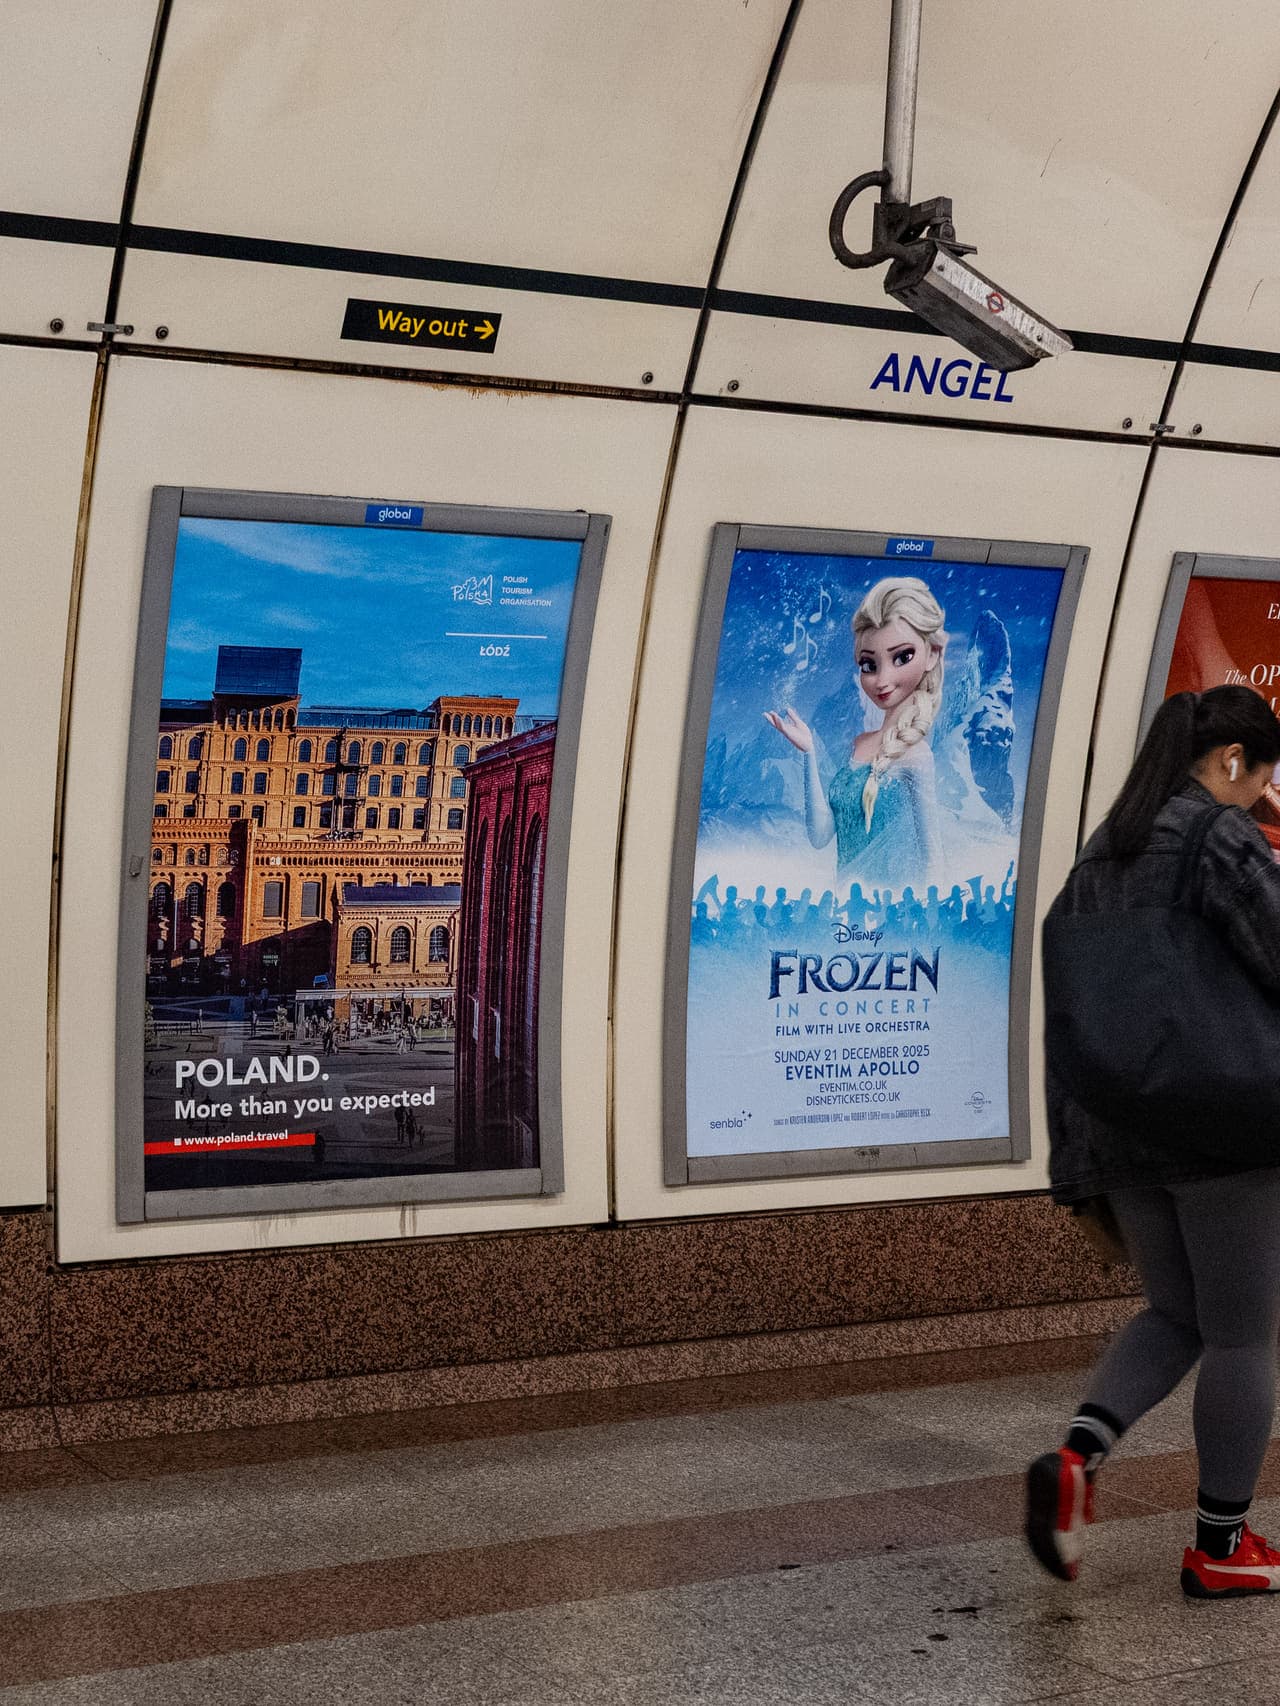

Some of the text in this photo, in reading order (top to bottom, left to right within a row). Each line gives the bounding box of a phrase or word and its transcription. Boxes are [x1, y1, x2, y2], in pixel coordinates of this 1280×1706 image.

[378, 309, 469, 338] Way out
[870, 352, 1014, 402] ANGEL
[378, 507, 412, 522] global
[896, 540, 924, 554] global
[502, 575, 529, 583] POLISH
[501, 586, 533, 595] TOURISM
[499, 598, 552, 607] ORGANISATION
[479, 643, 511, 657] ŁÓDŹ
[1224, 669, 1248, 685] The
[831, 922, 884, 947] Disney
[767, 945, 942, 1000] FROZEN
[776, 998, 930, 1018] IN CONCERT
[776, 1020, 930, 1036] FILM WITH LIVE ORCHESTRA
[774, 1044, 930, 1063] SUNDAY 21 DECEMBER 2025
[175, 1054, 330, 1089] POLAND.
[786, 1060, 920, 1081] EVENTIM APOLLO
[819, 1080, 887, 1093] EVENTIM.CO.UK
[175, 1085, 436, 1120] More than you expected
[806, 1092, 901, 1106] DISNEYTICKETS.CO.UK
[710, 1117, 743, 1129] senbla
[184, 1129, 288, 1146] www.poland.travel
